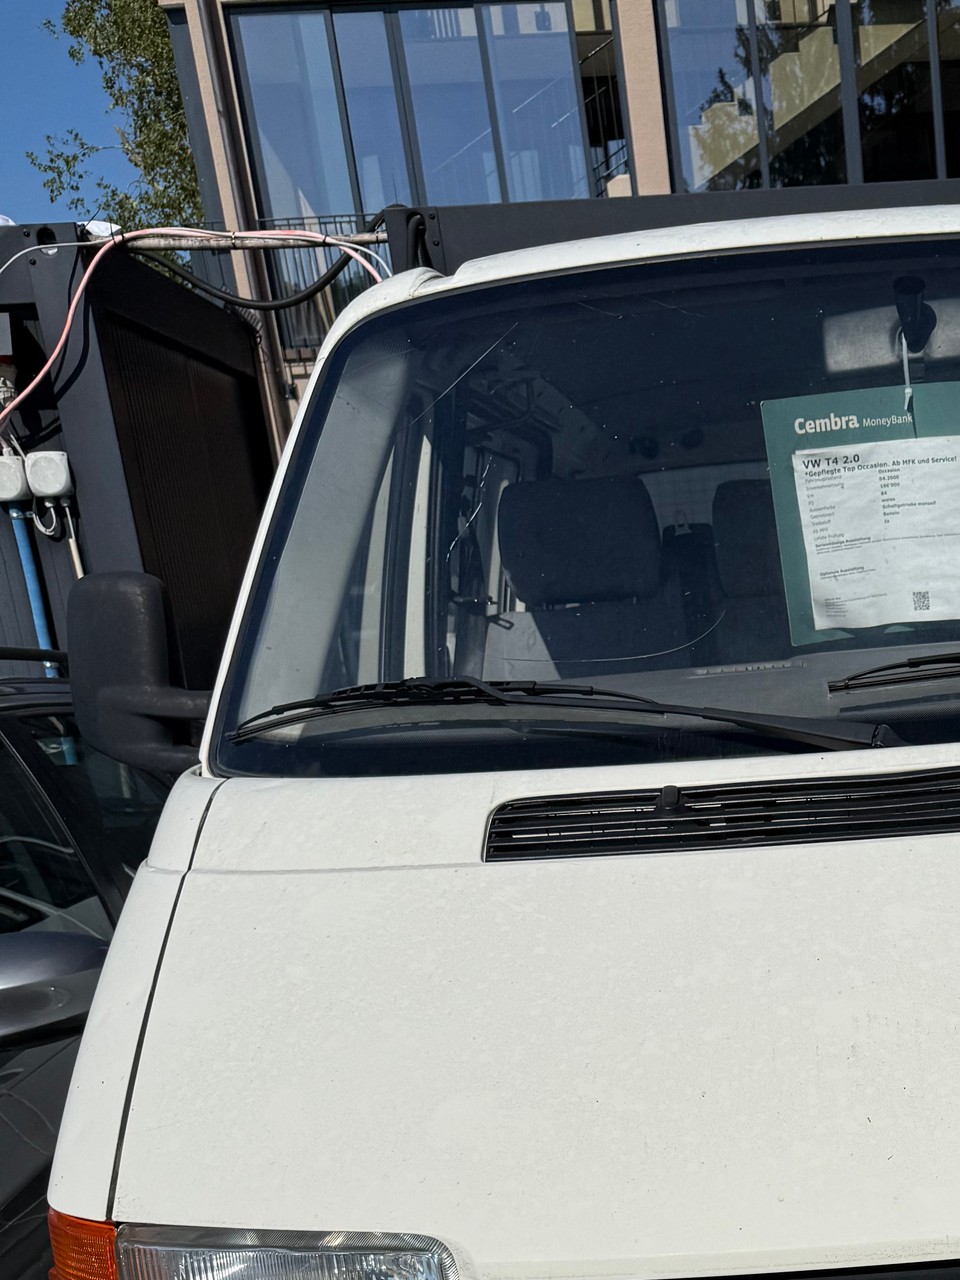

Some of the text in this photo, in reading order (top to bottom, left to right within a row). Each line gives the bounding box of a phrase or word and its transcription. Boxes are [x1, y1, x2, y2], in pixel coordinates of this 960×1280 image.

[794, 412, 913, 435] Cembra MoneyBank
[802, 454, 860, 469] VW T4 2.0
[857, 461, 890, 471] Occasion.
[902, 458, 916, 466] MFK
[917, 457, 930, 465] und
[931, 455, 957, 463] Service!
